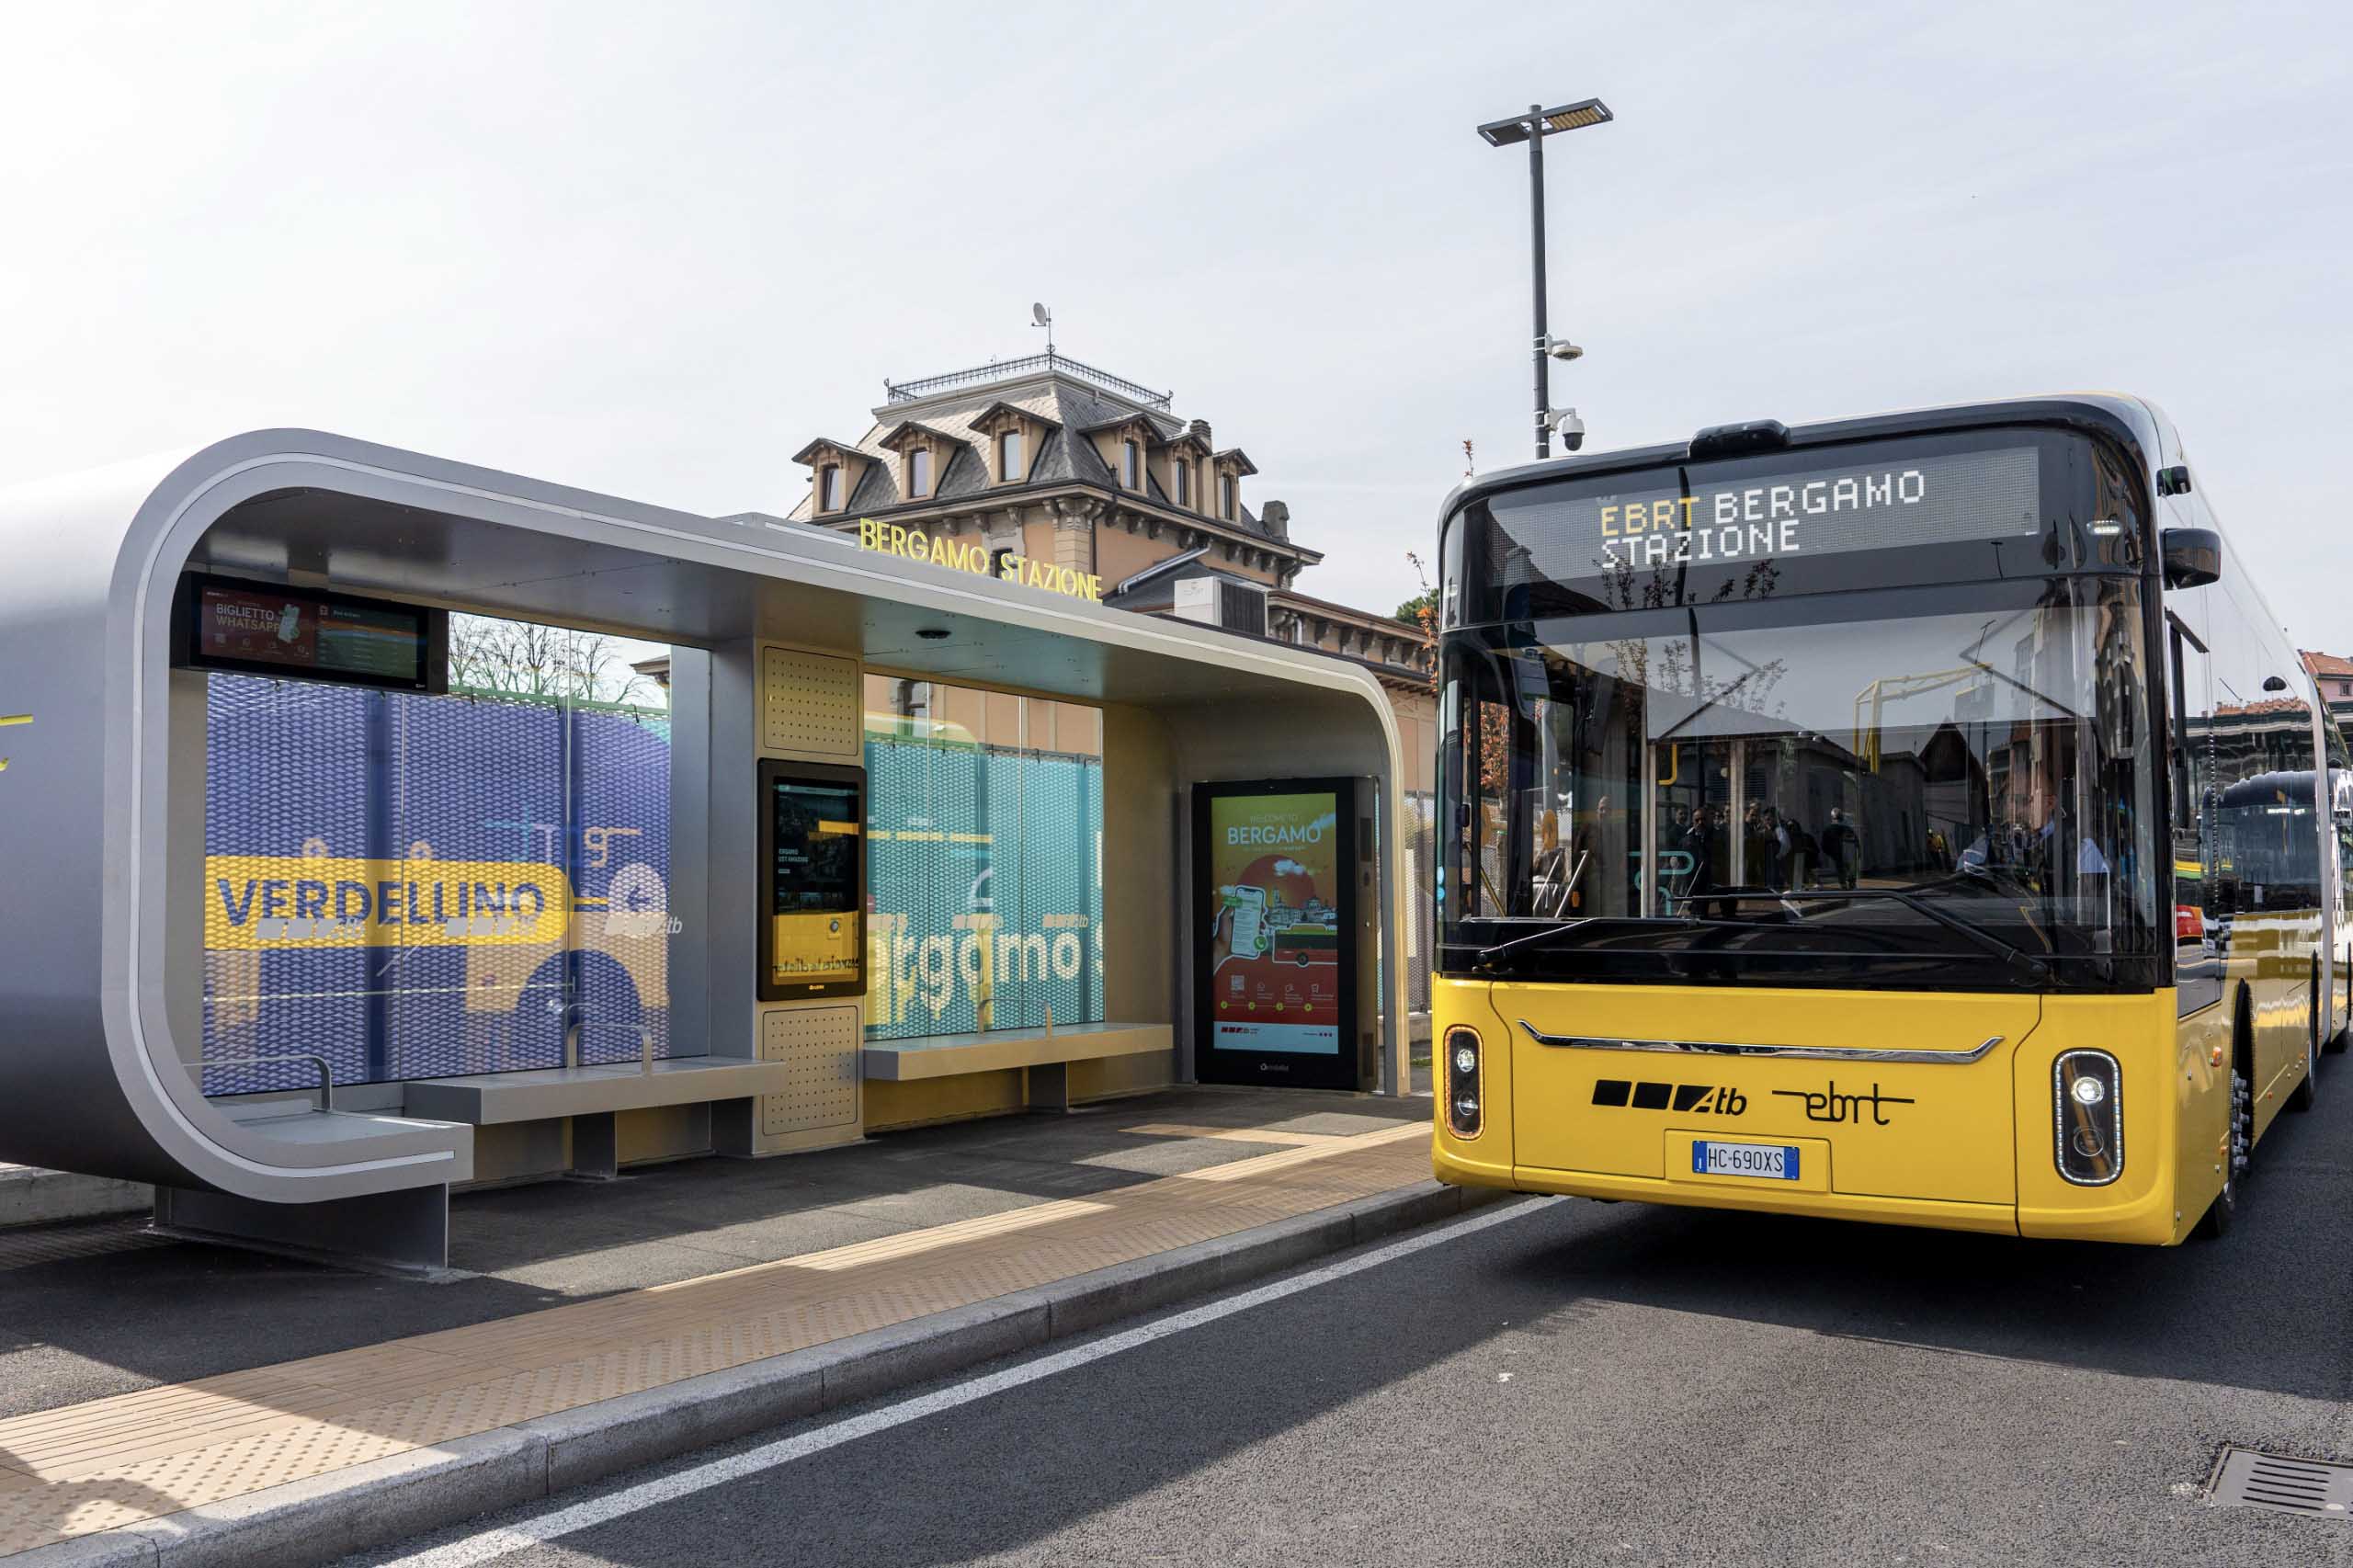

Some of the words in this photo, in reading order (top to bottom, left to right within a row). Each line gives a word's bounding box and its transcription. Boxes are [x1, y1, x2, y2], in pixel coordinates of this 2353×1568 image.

[1601, 496, 1700, 537] EBRT
[1714, 470, 1925, 526] BERGAMO
[860, 517, 990, 574] BERGAMO
[1000, 553, 1103, 603] STAZIONE
[1600, 519, 1800, 569] STAZIONE
[216, 603, 274, 621] BIGLIETTO
[216, 615, 279, 633] WHATSAPP
[1227, 825, 1322, 845] BERGAMO
[217, 879, 546, 927] VERDELLINO
[1772, 1080, 1915, 1125] ebrt
